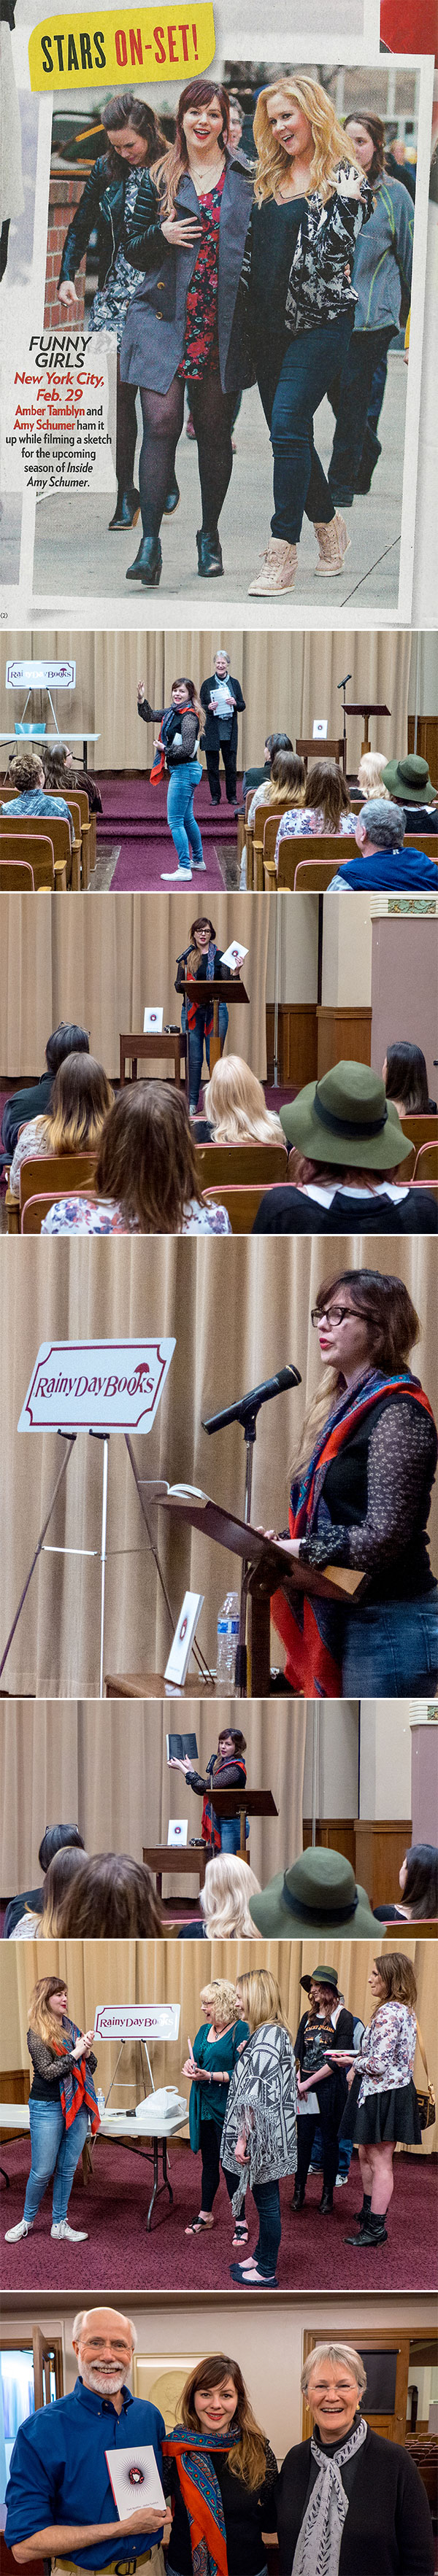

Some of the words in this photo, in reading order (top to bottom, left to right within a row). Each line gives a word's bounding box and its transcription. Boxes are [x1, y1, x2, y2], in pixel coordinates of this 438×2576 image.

[41, 31, 107, 73] STARS
[115, 24, 199, 66] ON-SET!
[28, 336, 92, 351] FUNNY
[35, 352, 85, 368] GIRLS
[14, 372, 43, 384] New
[46, 372, 74, 384] York
[77, 372, 104, 388] City,
[36, 388, 61, 401] Feb.
[65, 389, 83, 402] 29
[15, 405, 45, 416] Amber
[47, 405, 85, 419] Tamblyn
[86, 405, 103, 416] and
[13, 419, 34, 432] Amy
[36, 419, 75, 430] Schumer
[77, 419, 96, 430] ham
[98, 421, 104, 430] it
[6, 436, 17, 446] up
[19, 433, 42, 444] while
[44, 433, 74, 446] filming
[83, 433, 112, 444] sketch
[21, 447, 34, 458] for
[36, 447, 50, 458] the
[52, 449, 96, 461] upcoming
[24, 465, 54, 473] season
[55, 462, 66, 473] of
[66, 462, 93, 473] Inside
[26, 476, 47, 489] Amy
[49, 476, 90, 487] Schumer.
